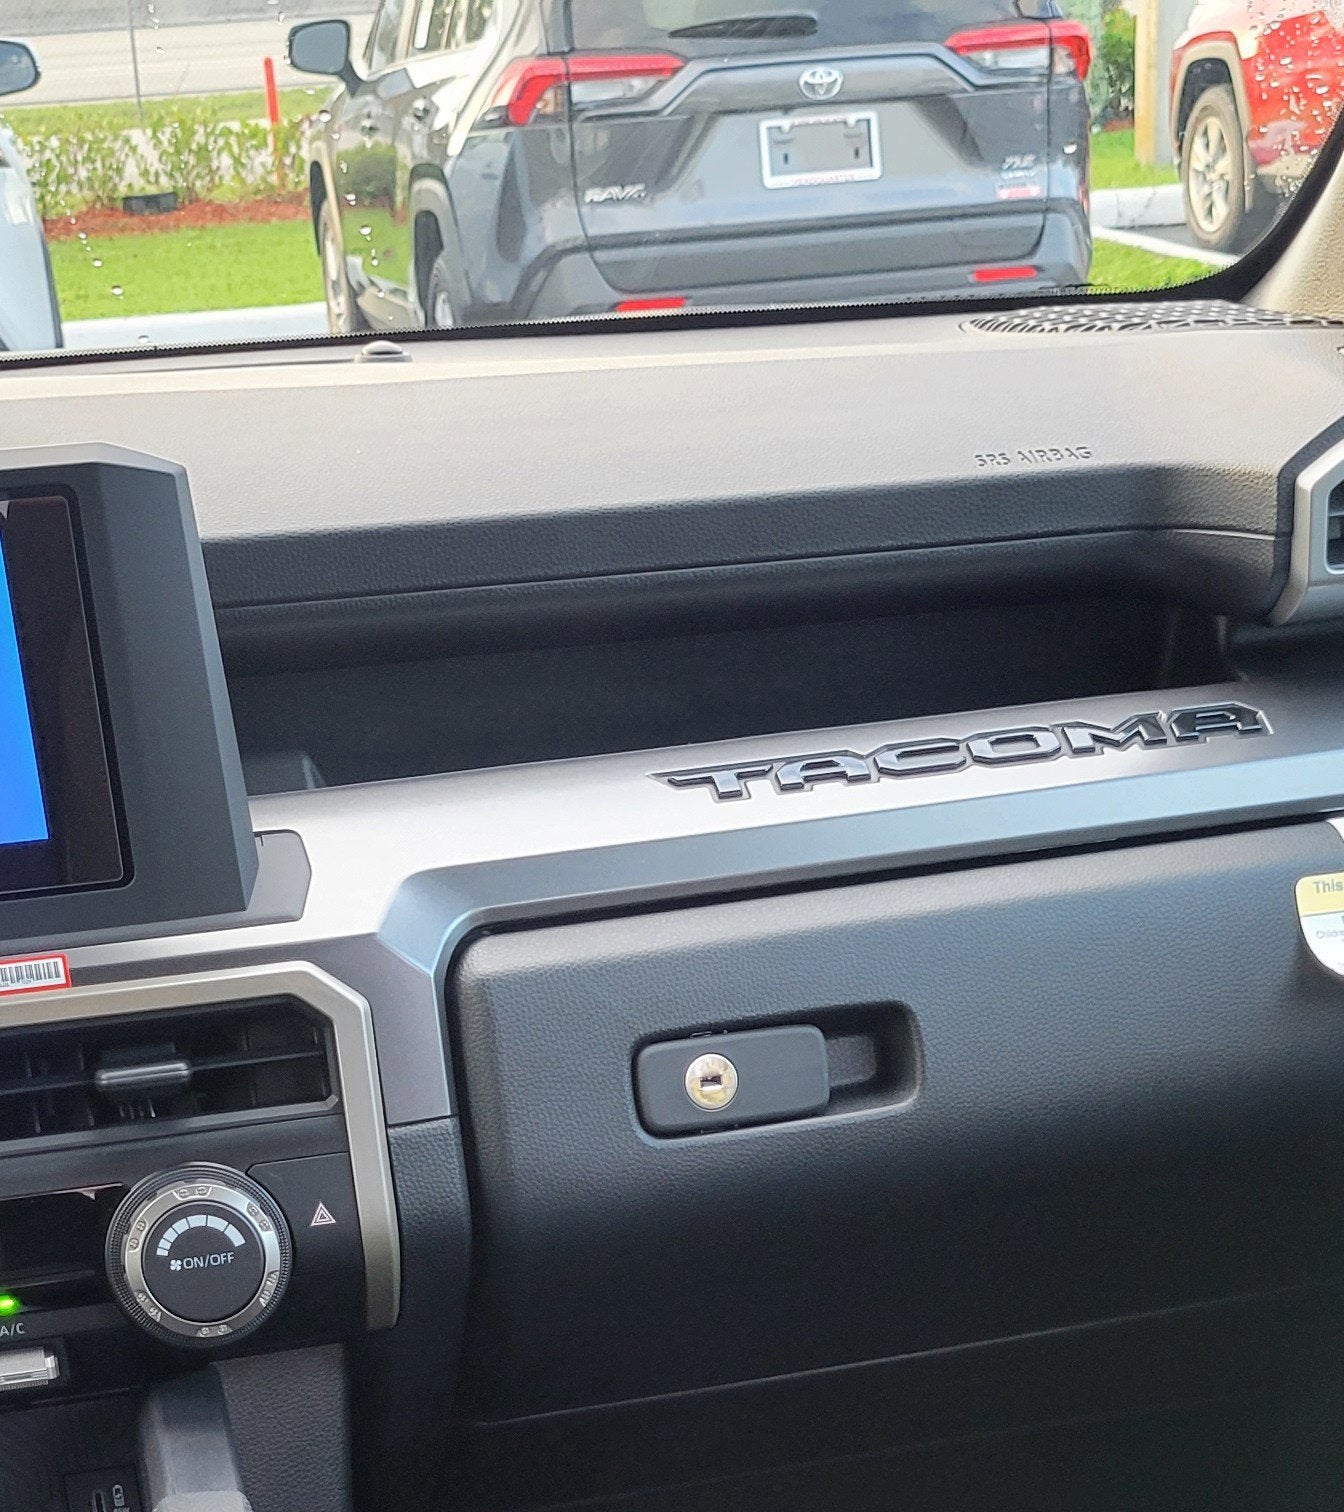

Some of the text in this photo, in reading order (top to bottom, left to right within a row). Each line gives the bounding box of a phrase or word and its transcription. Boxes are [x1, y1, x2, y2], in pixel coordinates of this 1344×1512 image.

[974, 446, 1092, 467] SRS AIRBAG
[652, 701, 1274, 802] TACOMA
[1313, 880, 1343, 895] This
[182, 1252, 235, 1270] ON/OFF
